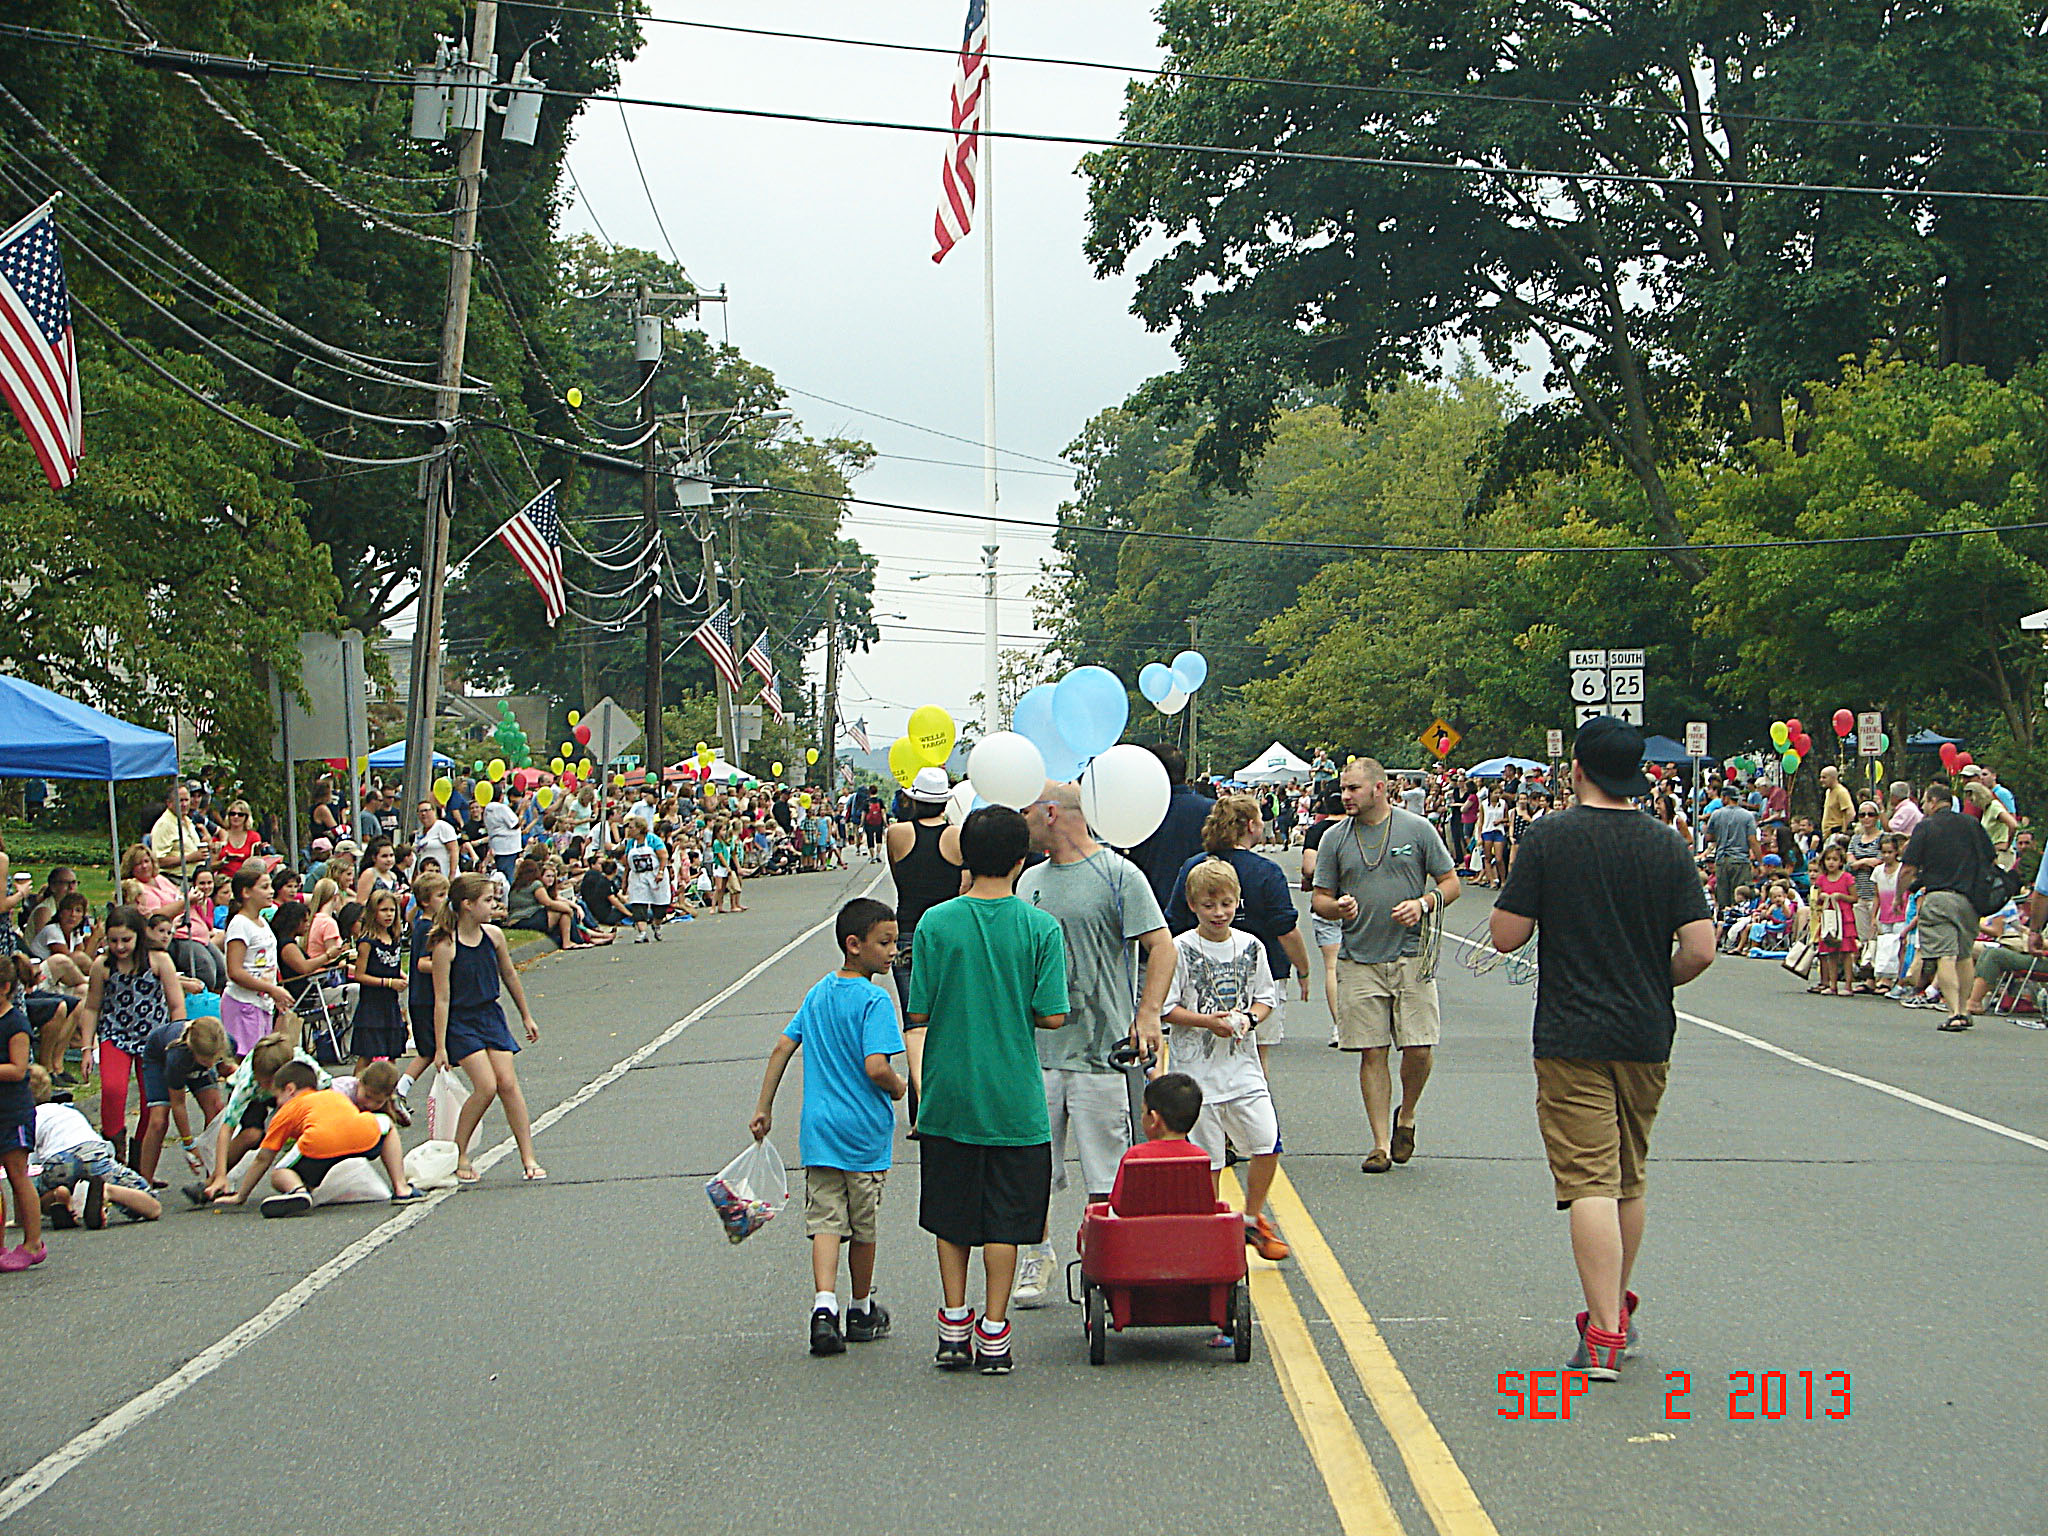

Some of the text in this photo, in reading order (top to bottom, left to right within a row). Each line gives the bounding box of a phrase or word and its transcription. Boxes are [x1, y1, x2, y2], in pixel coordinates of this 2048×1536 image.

[1575, 654, 1599, 665] EAST
[1611, 653, 1642, 664] SOUTH
[1582, 676, 1595, 696] 6
[1615, 675, 1640, 696] 25
[919, 732, 946, 743] WELLS
